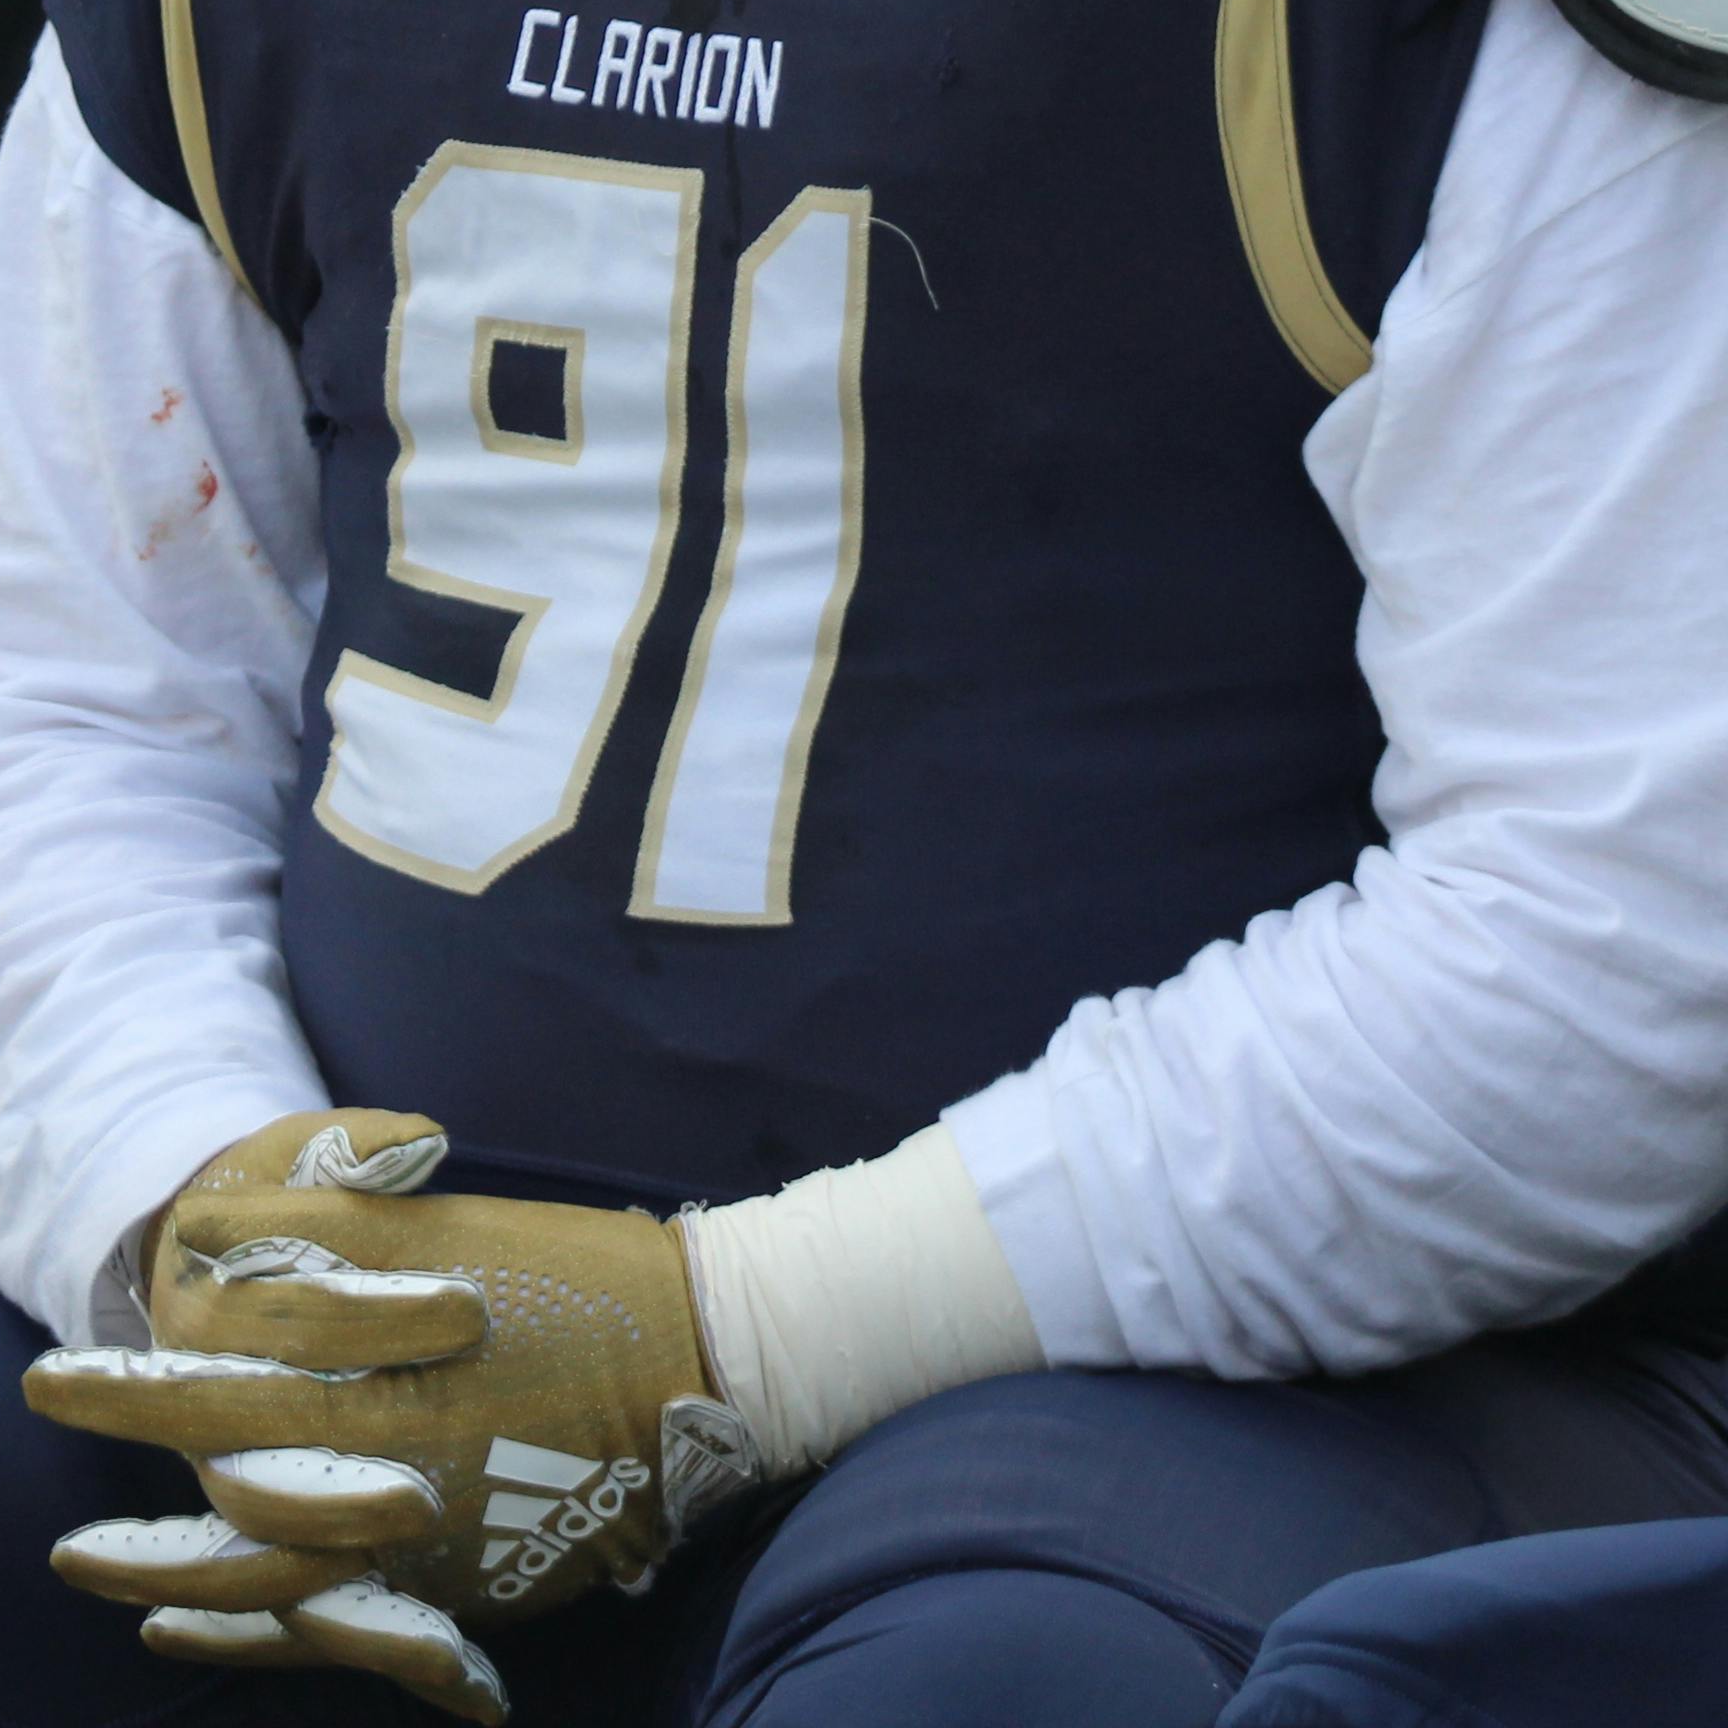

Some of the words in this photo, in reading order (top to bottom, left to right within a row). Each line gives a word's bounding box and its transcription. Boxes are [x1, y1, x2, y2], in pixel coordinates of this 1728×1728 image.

[507, 8, 783, 129] CLARION
[312, 139, 872, 927] 91
[488, 1456, 650, 1600] adidas
